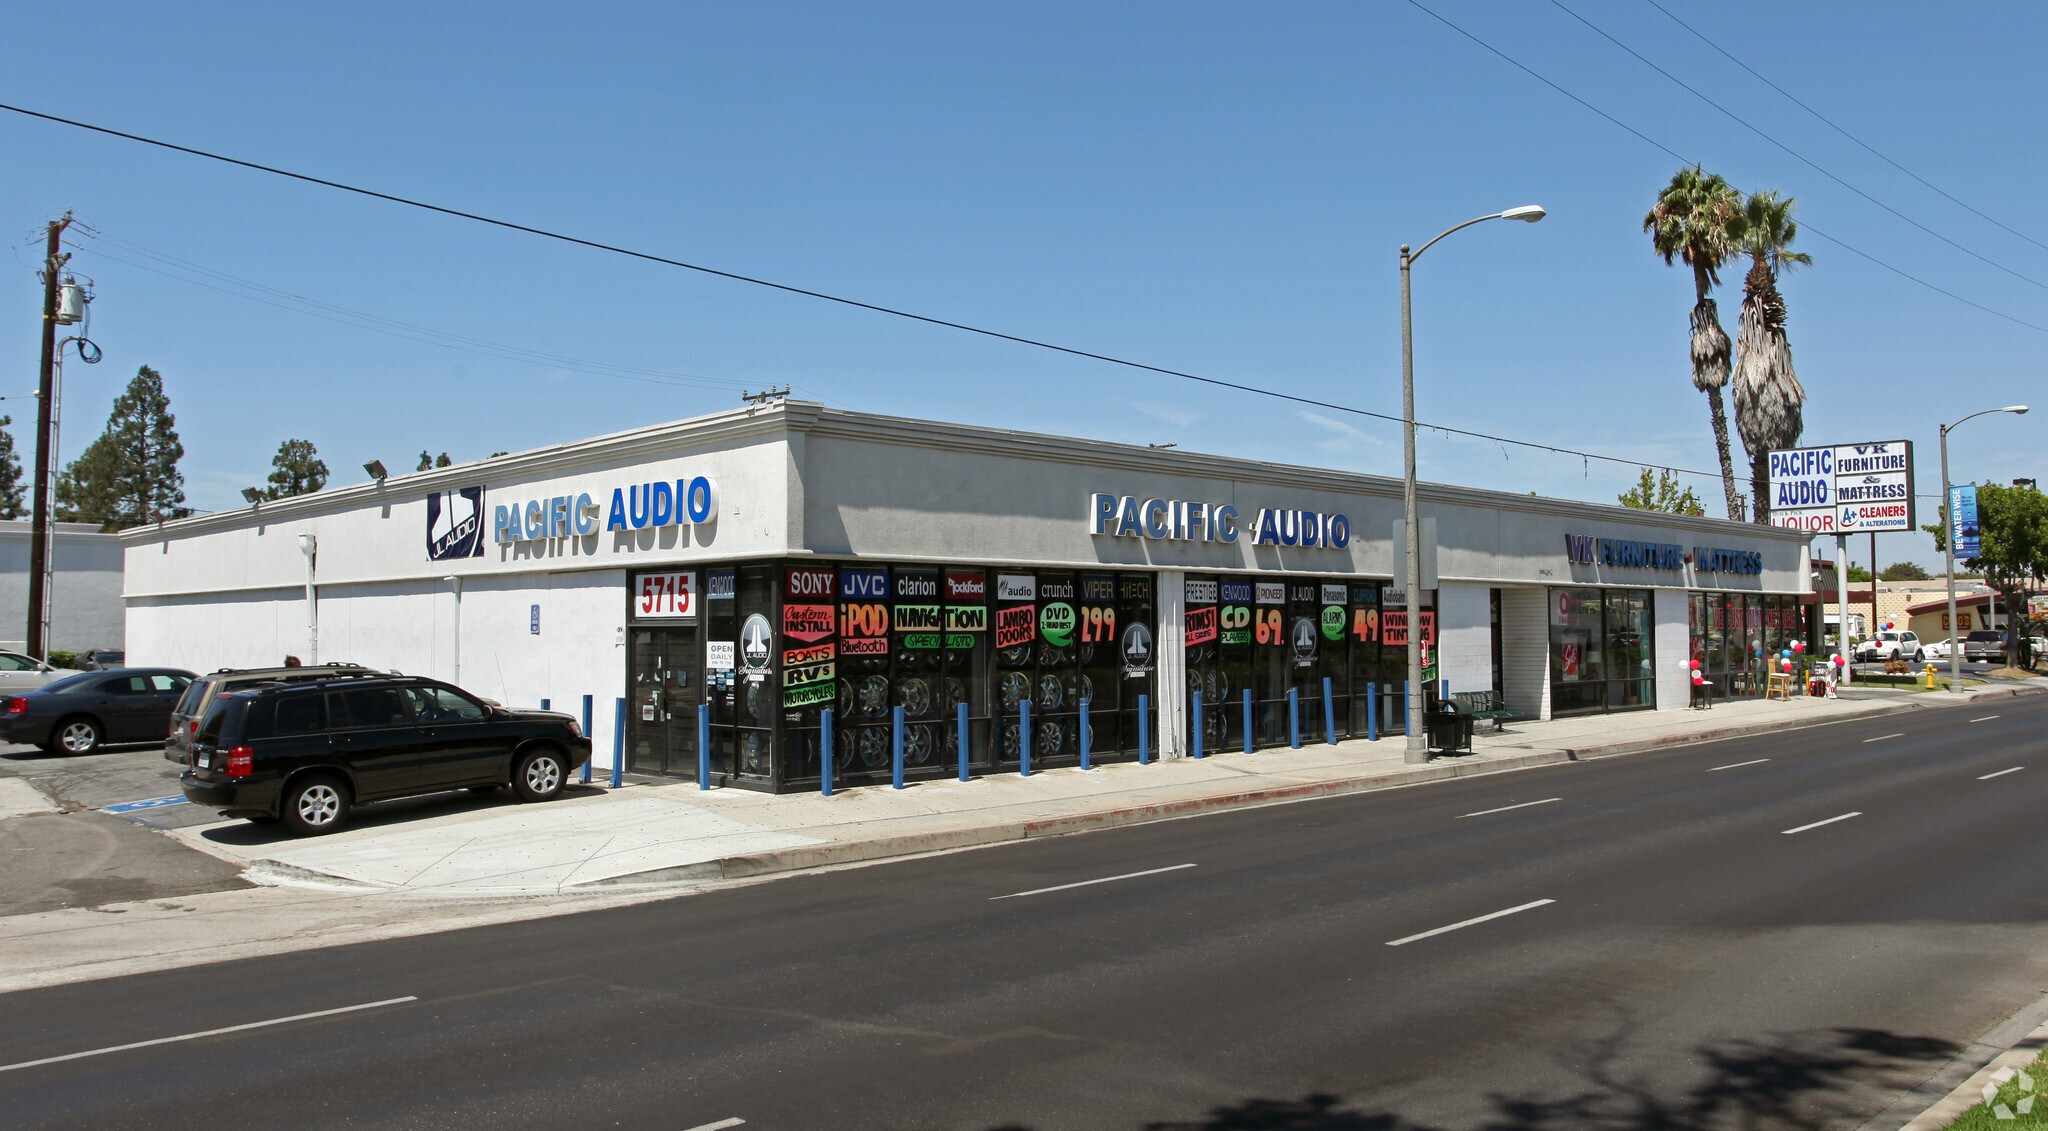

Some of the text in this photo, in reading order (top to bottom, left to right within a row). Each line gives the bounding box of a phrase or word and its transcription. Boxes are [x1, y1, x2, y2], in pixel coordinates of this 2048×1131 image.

[1771, 449, 1832, 477] PACIFIC
[1838, 454, 1905, 472] FURNITURE
[1862, 475, 1881, 484] &
[1778, 479, 1828, 506] AUDIO
[1839, 484, 1906, 500] MATTRESS
[1953, 489, 1961, 509] WISE
[495, 476, 717, 544] PACIFIC AUDIO
[1842, 505, 1906, 524] A+ CLEANERS
[1090, 493, 1350, 549] PACIFIC AUDIO
[1865, 519, 1906, 527] ALTERATIONS
[1954, 510, 1963, 538] WATER
[445, 516, 476, 549] AUDIO
[1567, 534, 1763, 575] VK FURNITURE MATTRESS
[791, 571, 834, 595] SONY
[844, 574, 884, 596] JVC
[1007, 586, 1032, 597] audio
[1041, 580, 1074, 598] crunch
[1083, 581, 1114, 599] VIPER
[1186, 583, 1217, 600] PRESTIGE
[641, 575, 690, 615] 5715
[1221, 584, 1251, 601] KENWOOD
[1260, 587, 1283, 600] PIONEER
[1323, 587, 1346, 602] Panasonic
[785, 606, 832, 620] Custom
[841, 603, 888, 636] iPOD
[997, 608, 1033, 631] LAMBO
[1046, 607, 1070, 621] DVD
[1220, 605, 1250, 629] CD
[1322, 610, 1343, 625] ALARMS
[1385, 614, 1431, 627] WINOW
[785, 620, 832, 633] INSTALL
[1352, 608, 1379, 642] 49
[908, 634, 972, 647] SPECILISTS
[997, 625, 1032, 646] DOORS
[786, 646, 831, 664] BOATS
[841, 640, 886, 653] Bluetooth
[784, 685, 834, 706] MOTORCYCLES
